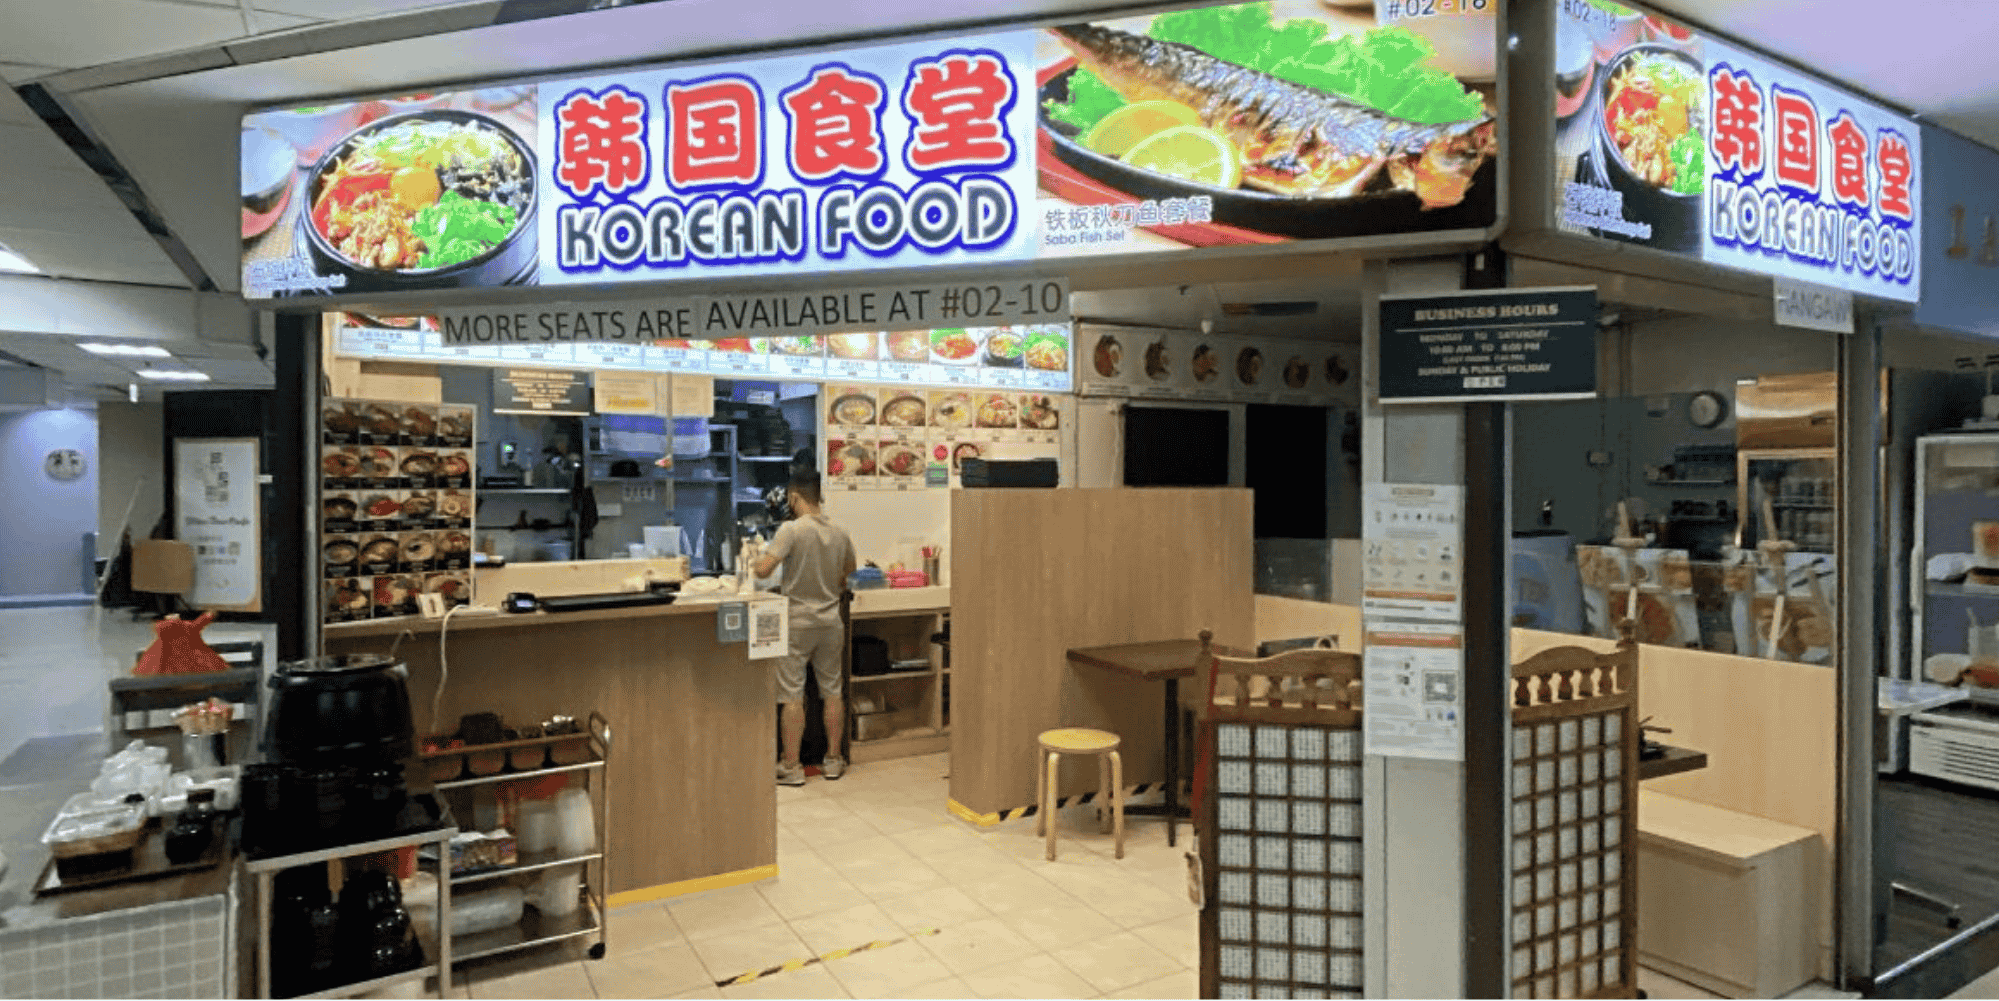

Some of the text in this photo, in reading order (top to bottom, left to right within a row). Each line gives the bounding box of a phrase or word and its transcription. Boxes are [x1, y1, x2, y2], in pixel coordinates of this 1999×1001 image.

[557, 54, 1012, 195] 韩国食堂
[1711, 67, 1913, 223] 韩国食堂
[560, 177, 1014, 268] KOREAN FOOD
[1080, 231, 1102, 243] Fish
[1712, 177, 1839, 265] KOREAN
[1841, 211, 1914, 283] FOOD
[706, 281, 1062, 331] AVAILABLE AT #02-10
[1414, 303, 1559, 321] BUSINESS HOURS
[445, 308, 692, 343] MORE SEATS ARE
[1419, 329, 1549, 343] MONDAY TO SATURDAY
[1455, 344, 1473, 354] AM
[1481, 343, 1495, 352] TO
[1523, 341, 1541, 351] PM
[1418, 366, 1458, 376] SUNDAY
[1470, 364, 1506, 375] PUBLIC
[1507, 362, 1552, 373] HOLIDAY
